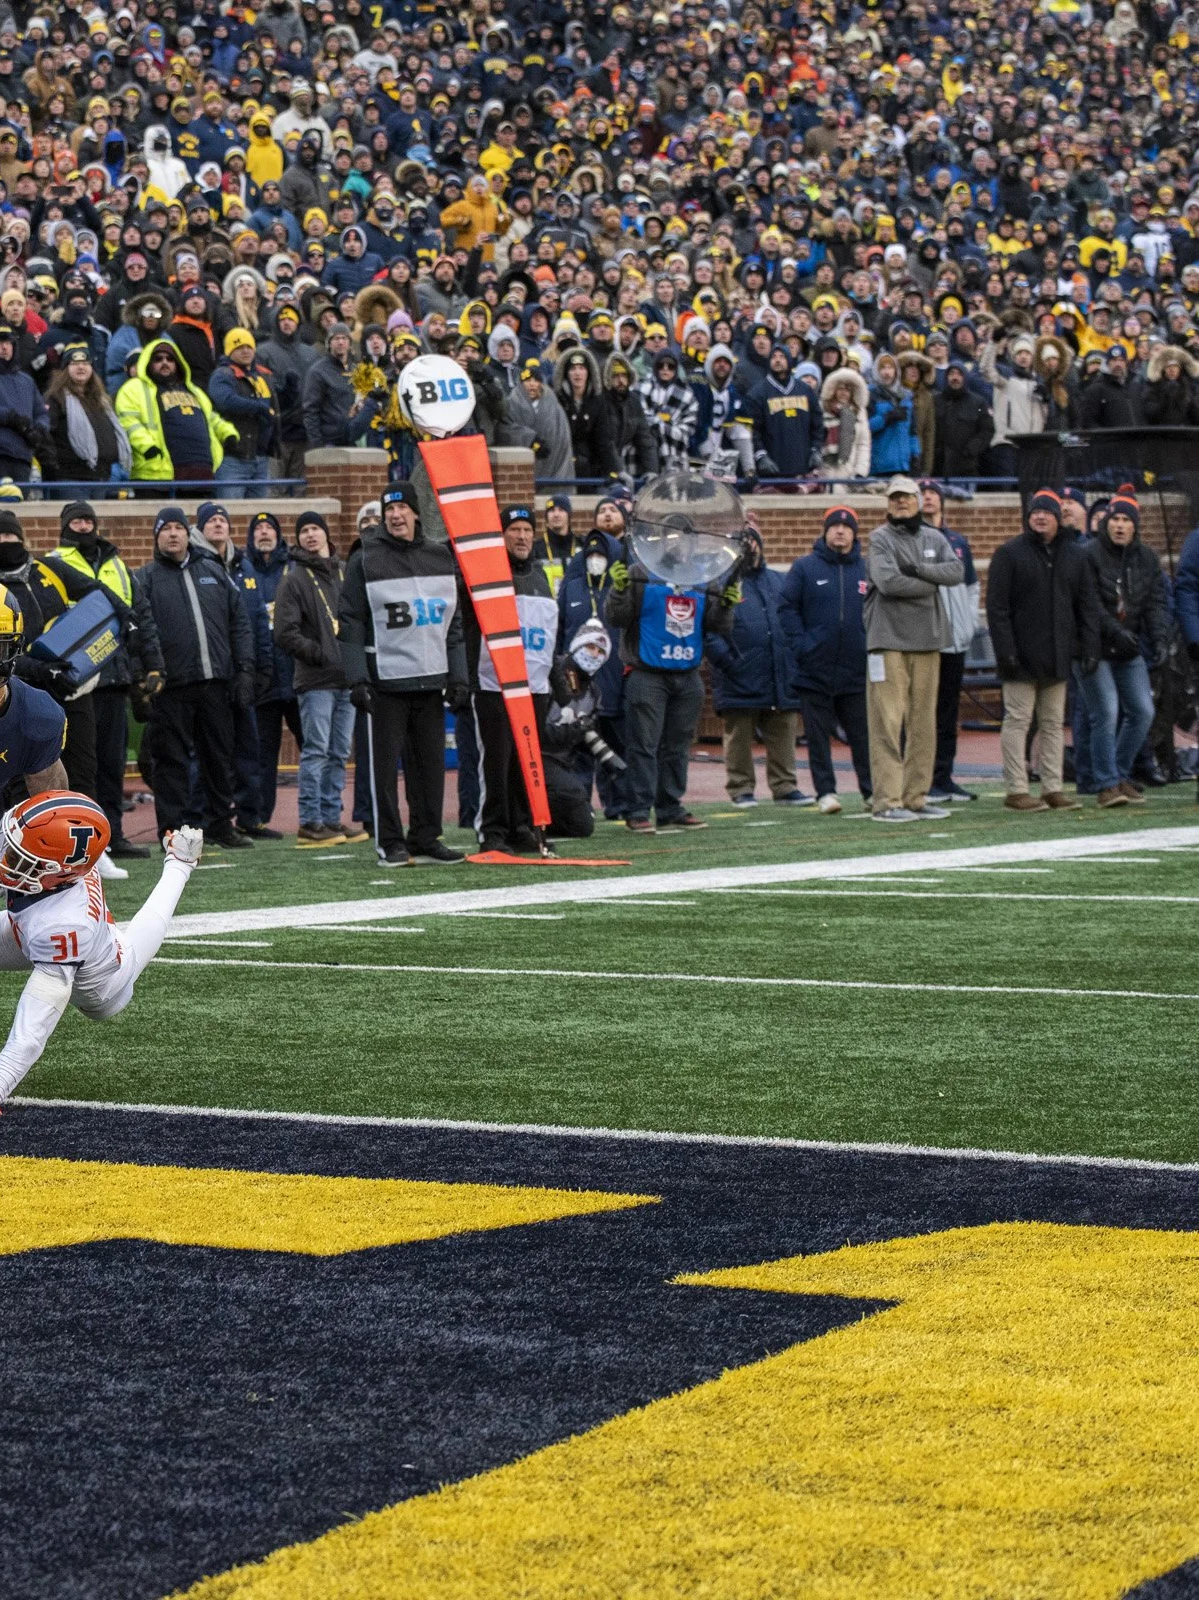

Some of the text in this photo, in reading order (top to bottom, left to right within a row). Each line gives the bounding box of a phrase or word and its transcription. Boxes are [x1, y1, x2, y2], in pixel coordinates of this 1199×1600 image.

[369, 5, 383, 29] 7
[244, 577, 257, 590] M
[64, 826, 95, 866] I
[50, 931, 78, 962] 31
